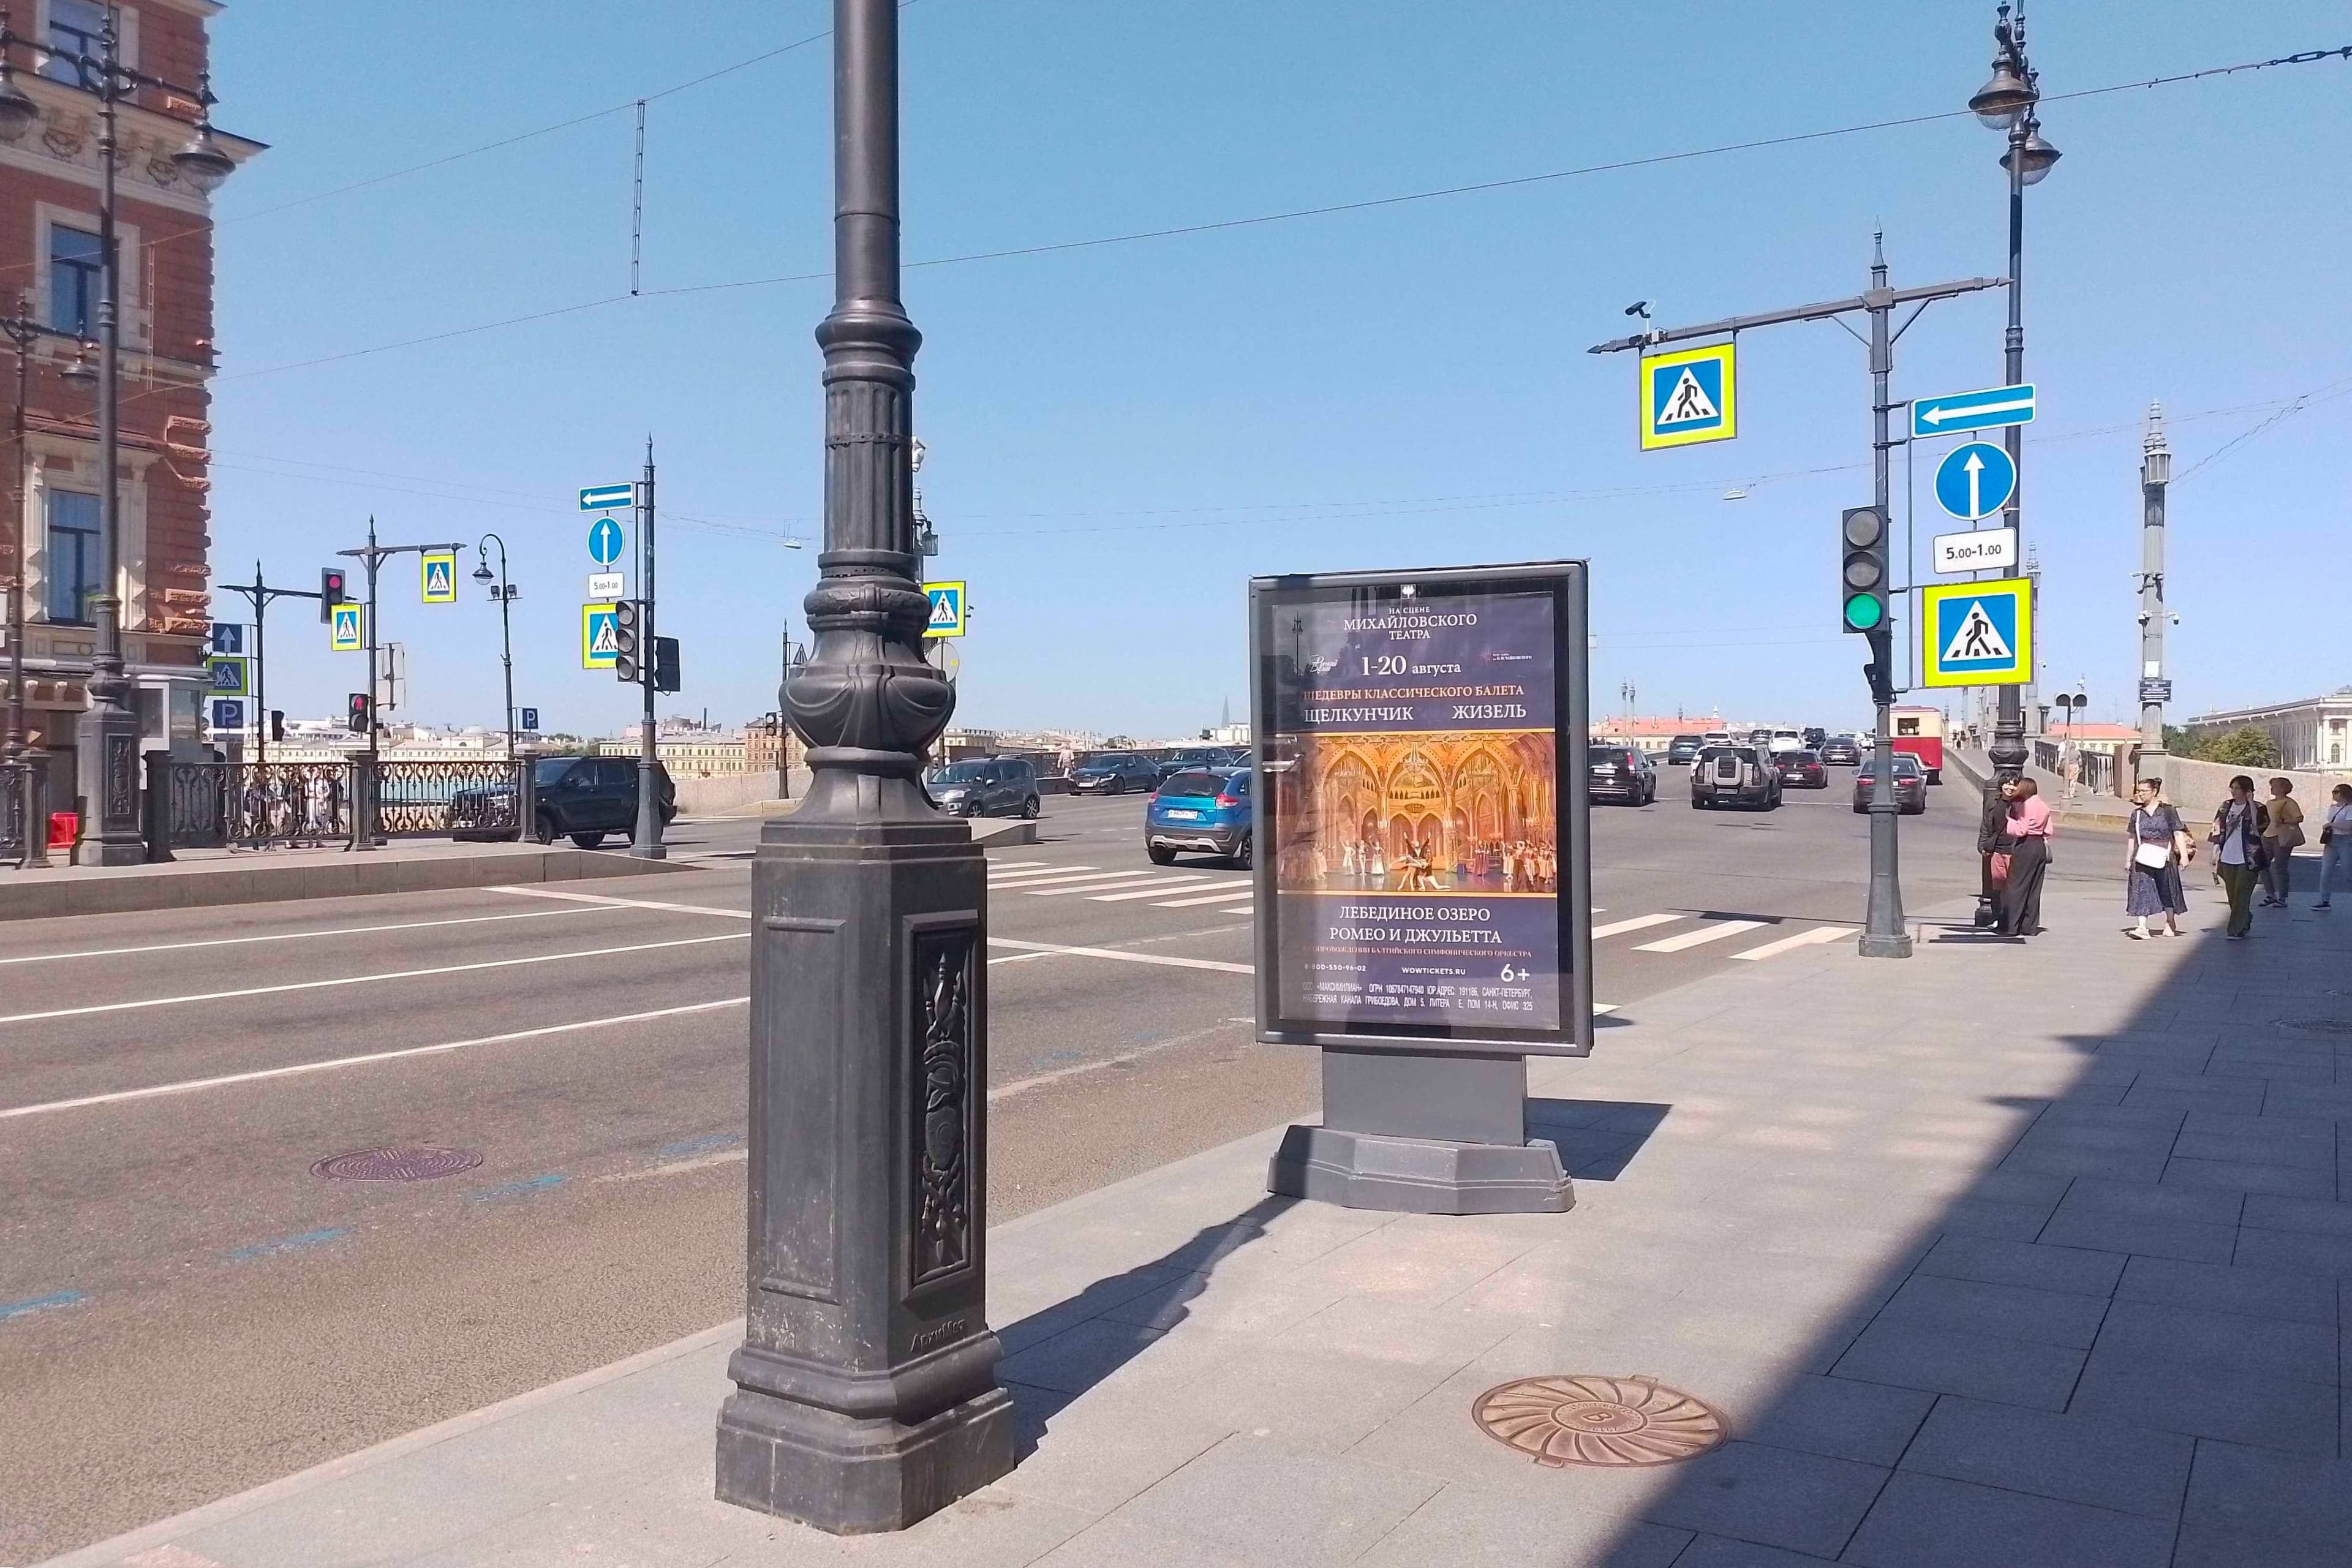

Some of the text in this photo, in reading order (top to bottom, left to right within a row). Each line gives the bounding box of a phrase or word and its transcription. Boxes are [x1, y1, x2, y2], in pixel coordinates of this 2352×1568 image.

[1947, 544, 2002, 560] 5.00-1.00
[1344, 614, 1477, 630] МИХАЙЛОВСКОГО
[1389, 630, 1431, 640] ТЕАТРА
[1362, 655, 1461, 677] 1-20 августа
[1304, 685, 1524, 701] ШЕДЕВРЫ КЛАССИЧЕСКОГО БАЛЕТА
[1304, 704, 1527, 725] ЩЕЛКУНЧИК ЖИЗЕЛЬ
[1340, 907, 1490, 922] ЛЕБЕДИНОЕ ОЗЕРО
[1329, 927, 1502, 944] РОМЕО И ДЖУЛЬЕТТА
[1501, 963, 1530, 982] 6+
[1369, 983, 1382, 993] ОГРН
[1341, 995, 1362, 1005] КАНАЛА
[1404, 997, 1417, 1008] ДОМ
[1430, 998, 1450, 1008] ЛИТЕРА
[1502, 1000, 1519, 1011] ОФИС
[1523, 1001, 1533, 1011] 325
